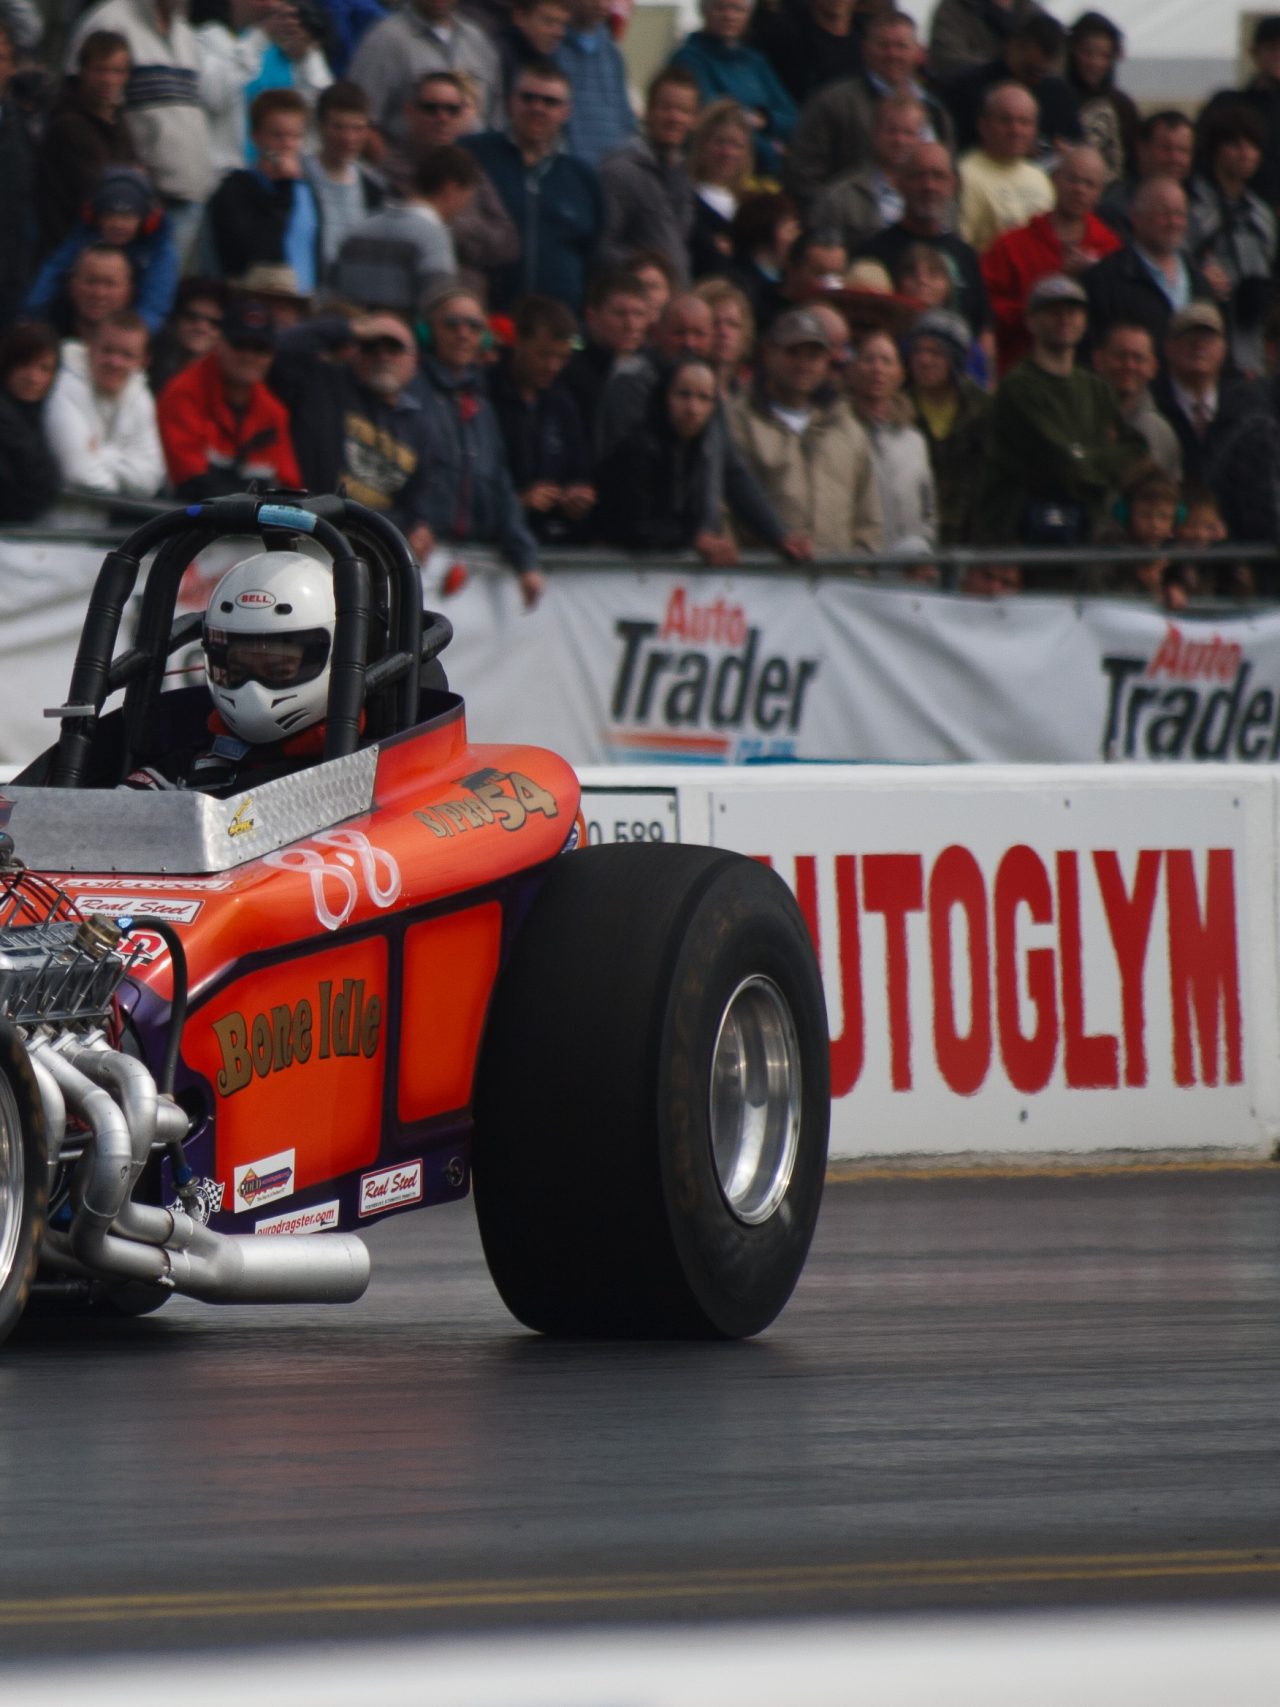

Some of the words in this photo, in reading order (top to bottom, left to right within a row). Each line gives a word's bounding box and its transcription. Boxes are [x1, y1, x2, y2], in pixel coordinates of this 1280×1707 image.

[658, 586, 747, 648] Auto
[609, 619, 819, 735] Trader
[1146, 621, 1243, 681] Auto
[451, 768, 558, 832] 54
[79, 899, 134, 911] Real
[134, 901, 194, 916] Steel
[748, 844, 1245, 1099] UTOGLYM
[212, 999, 312, 1097] Bone
[318, 979, 382, 1059] Idle
[364, 1177, 390, 1200] Real
[391, 1169, 418, 1193] Steel
